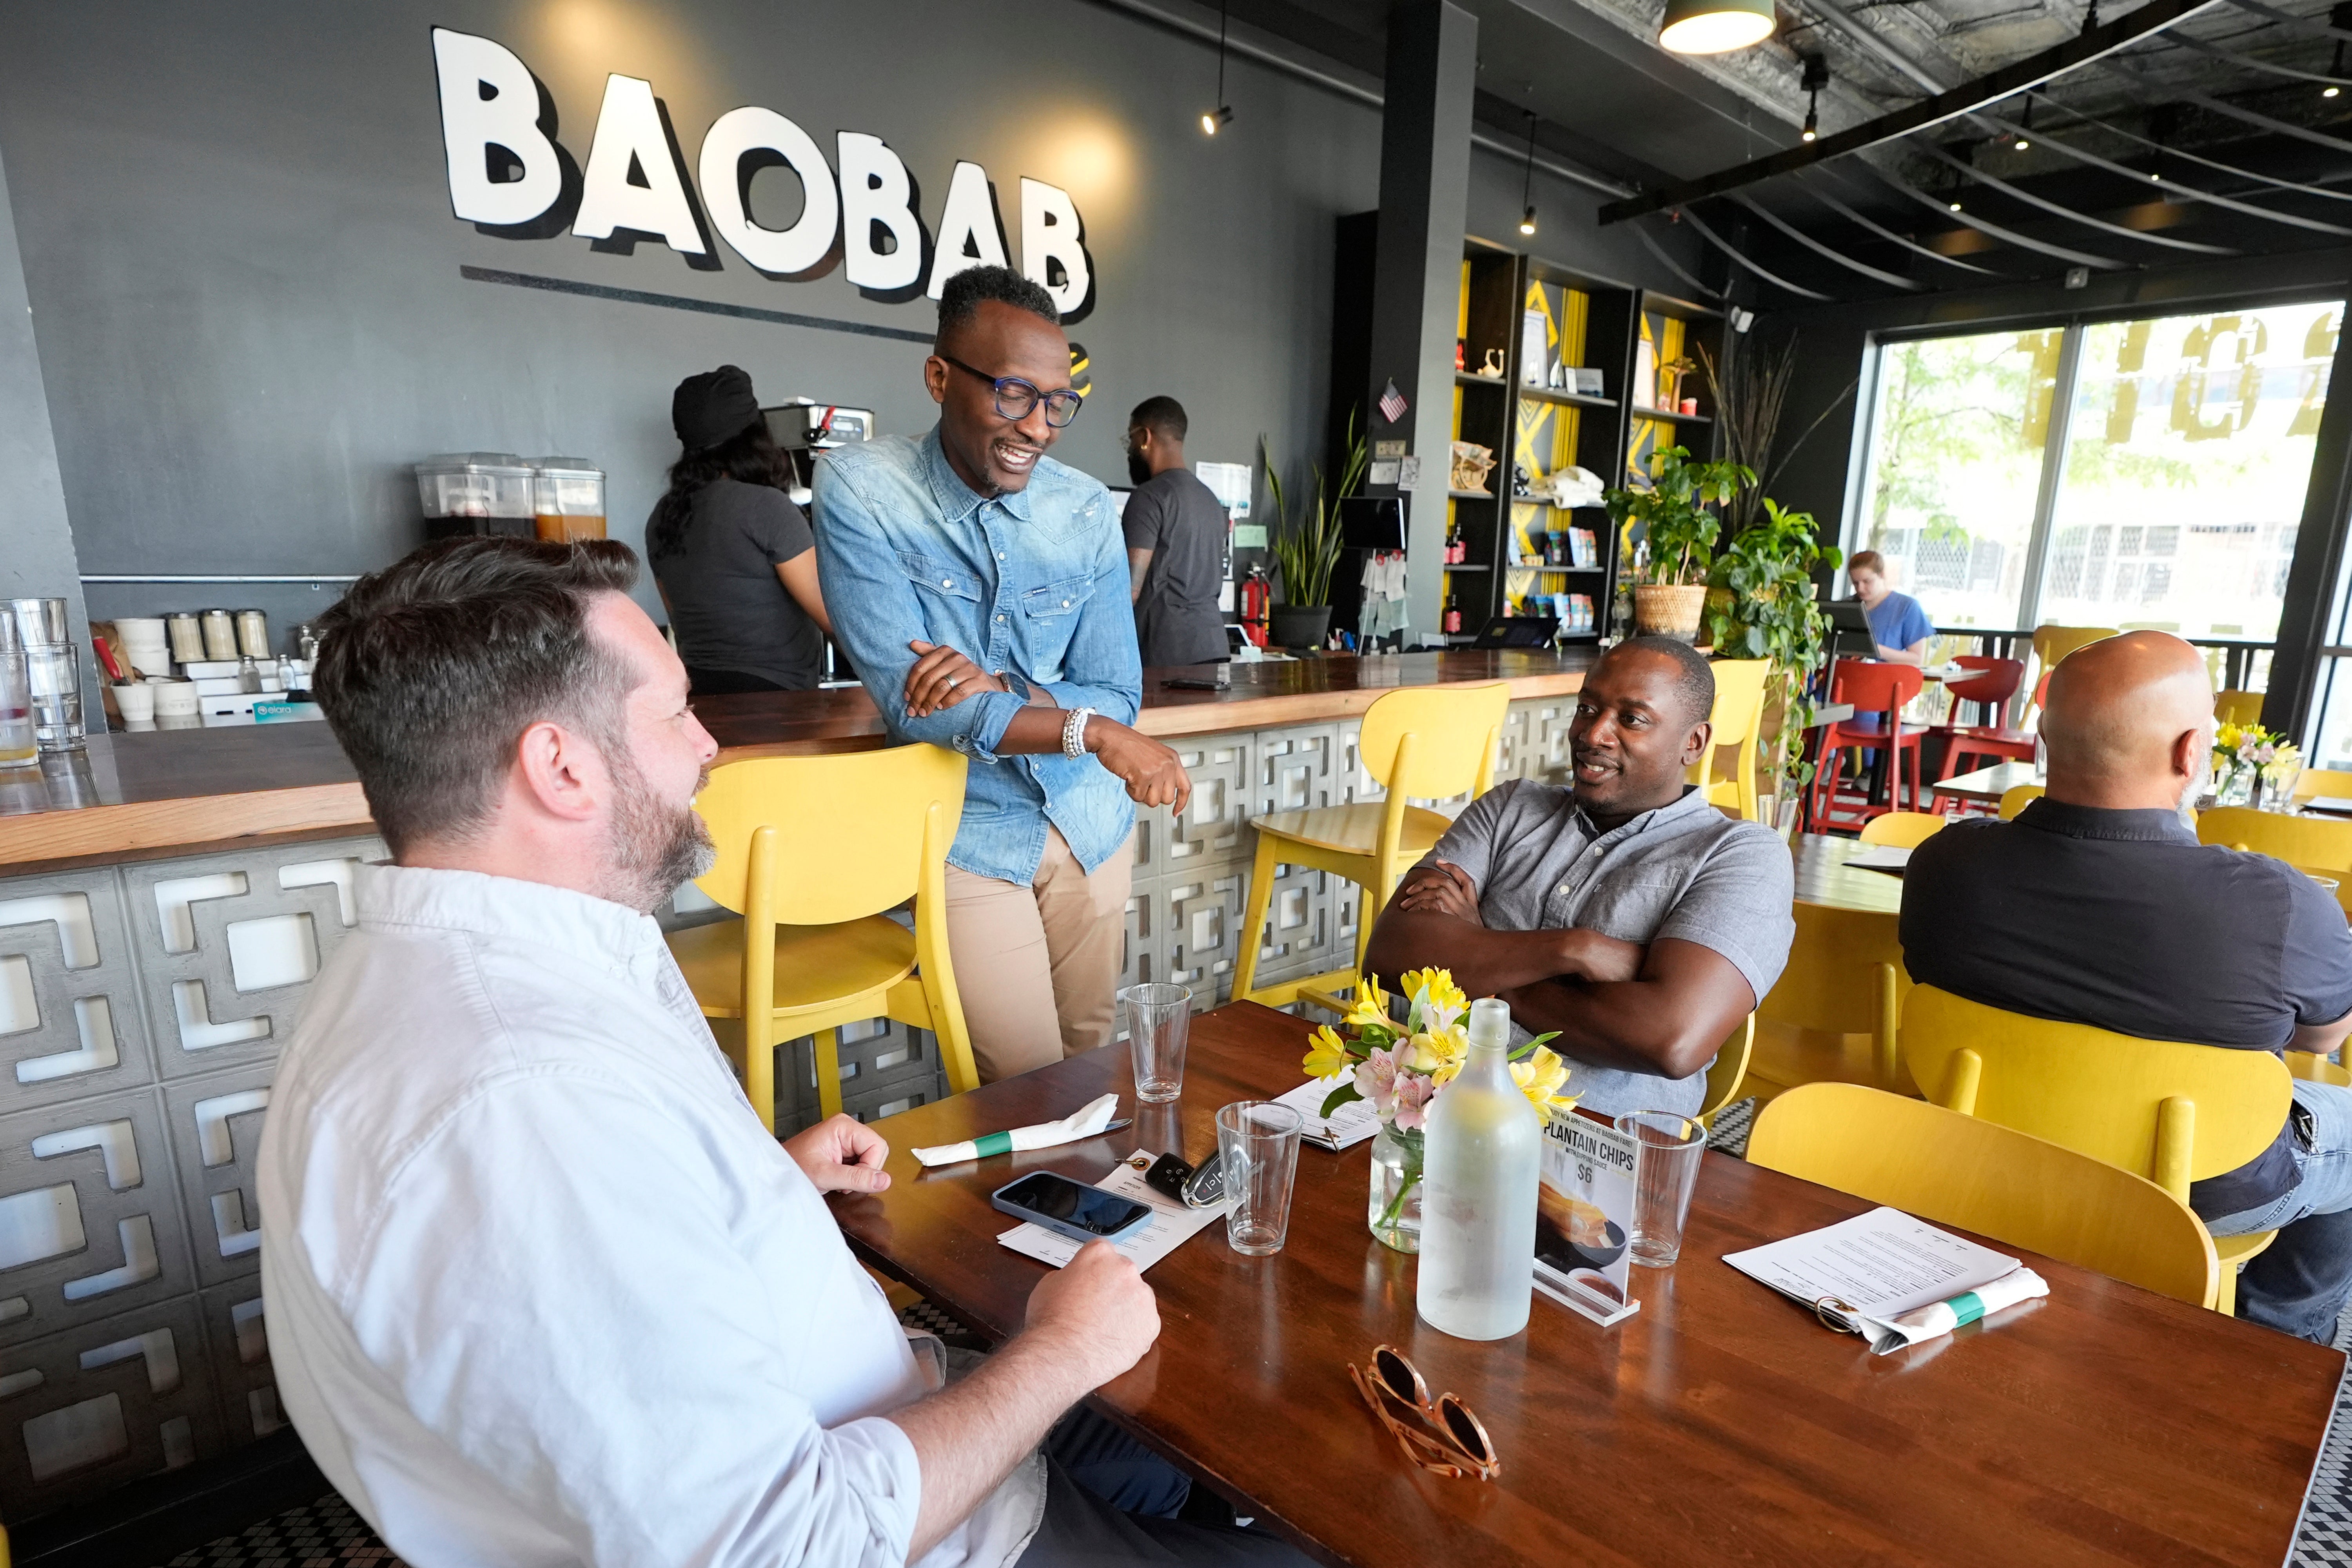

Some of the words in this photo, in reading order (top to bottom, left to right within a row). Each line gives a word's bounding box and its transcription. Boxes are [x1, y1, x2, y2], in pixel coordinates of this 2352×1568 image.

[432, 26, 1091, 314] BAOBAB
[1544, 1120, 1596, 1156] PLANTAIN
[1600, 1143, 1633, 1171] CHIPS
[1561, 1112, 1570, 1122] NEW
[1571, 1118, 1595, 1132] APPETIZERS
[1602, 1130, 1619, 1143] BAOBAB
[1620, 1138, 1632, 1148] FARE!
[1566, 1147, 1576, 1156] WITH
[1577, 1151, 1593, 1164] DIPPING
[1593, 1159, 1607, 1171] SAUCE
[1578, 1163, 1592, 1183] $6
